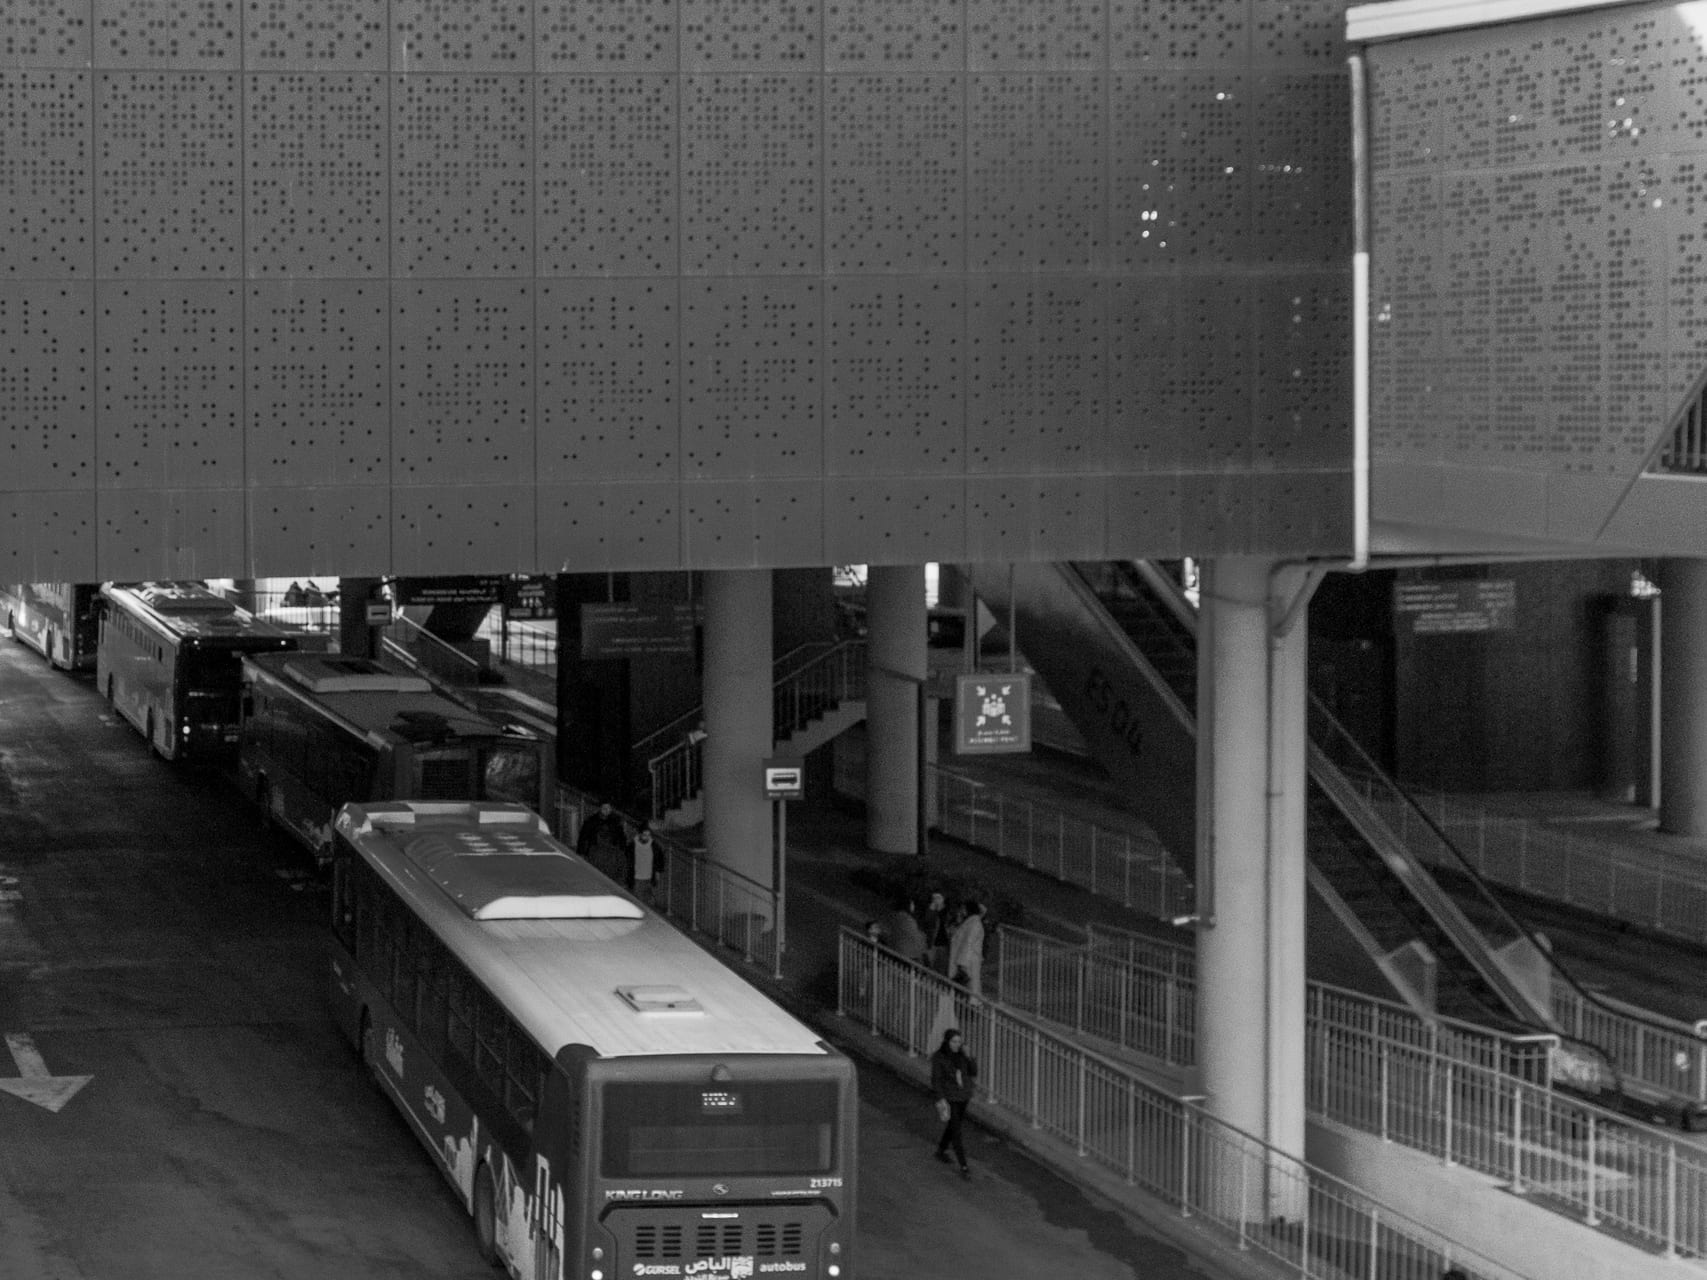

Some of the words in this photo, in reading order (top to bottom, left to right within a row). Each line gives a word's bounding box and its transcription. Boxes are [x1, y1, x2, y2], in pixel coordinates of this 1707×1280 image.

[606, 1190, 641, 1200] KING
[642, 1190, 683, 1200] LONG
[685, 1257, 731, 1275] الباص
[760, 1261, 806, 1272] autobus
